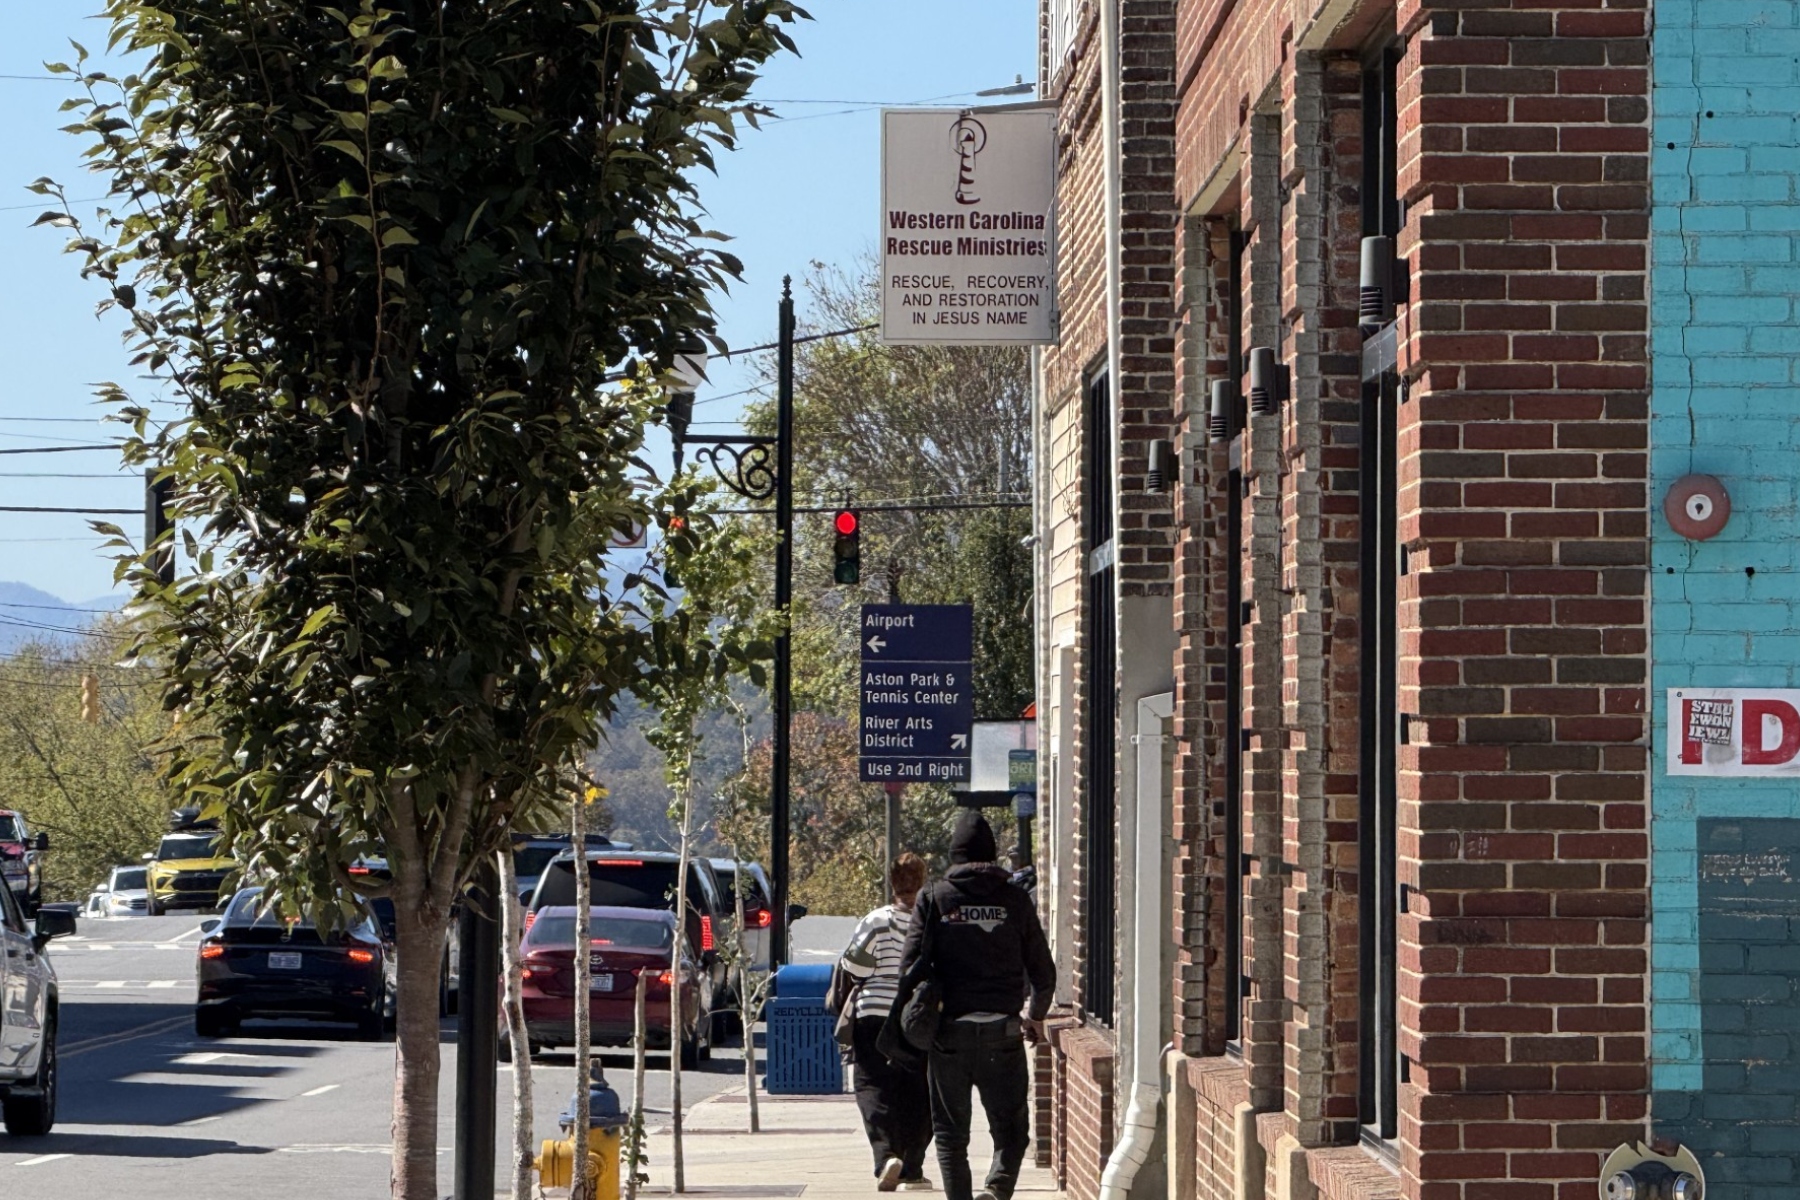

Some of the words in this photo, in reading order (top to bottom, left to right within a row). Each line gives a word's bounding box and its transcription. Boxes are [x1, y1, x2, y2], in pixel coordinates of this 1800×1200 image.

[889, 211, 964, 229] Western
[969, 211, 1045, 230] Carolina
[887, 237, 952, 256] Rescue
[957, 237, 1047, 256] Ministries
[892, 275, 955, 291] RESCUE,
[967, 275, 1049, 291] RECOVERY,
[902, 293, 932, 306] AND
[938, 293, 1039, 306] RESTORATION
[912, 311, 926, 324] IN
[933, 311, 980, 325] JESUS
[986, 311, 1028, 324] NAME
[866, 613, 914, 630] Airport
[865, 673, 904, 686] Aston
[910, 673, 940, 686] Park
[945, 673, 955, 686] &
[865, 690, 909, 704] Tennis
[914, 691, 959, 704] Center
[865, 716, 900, 730] River
[905, 717, 933, 730] Arts
[865, 733, 914, 748] District
[868, 763, 892, 776] Use
[897, 763, 922, 776] 2nd
[929, 763, 964, 780] Right
[960, 907, 1002, 920] HOME
